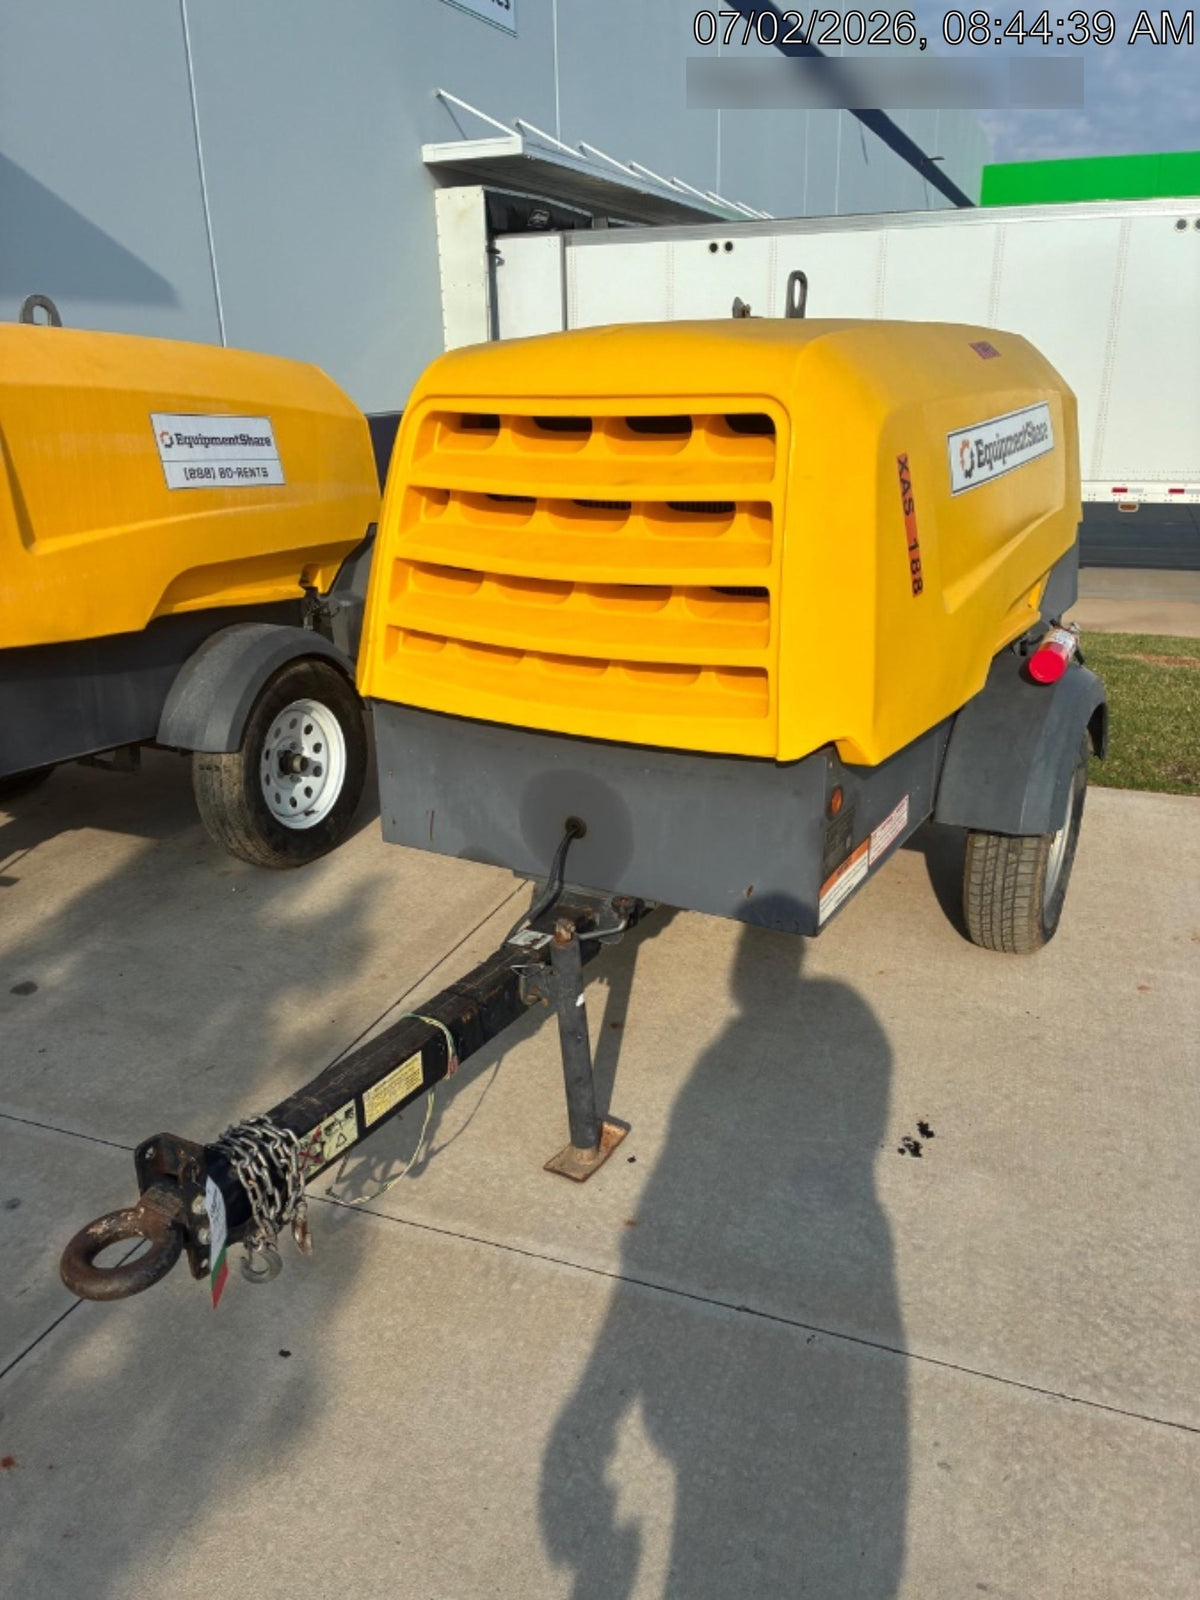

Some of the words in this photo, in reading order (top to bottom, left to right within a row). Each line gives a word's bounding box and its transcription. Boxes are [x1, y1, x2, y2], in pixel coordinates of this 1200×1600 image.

[174, 433, 272, 448] EquipmentShare
[974, 420, 1048, 470] EquipmentShare
[897, 455, 915, 516] XAS
[908, 538, 923, 595] 188
